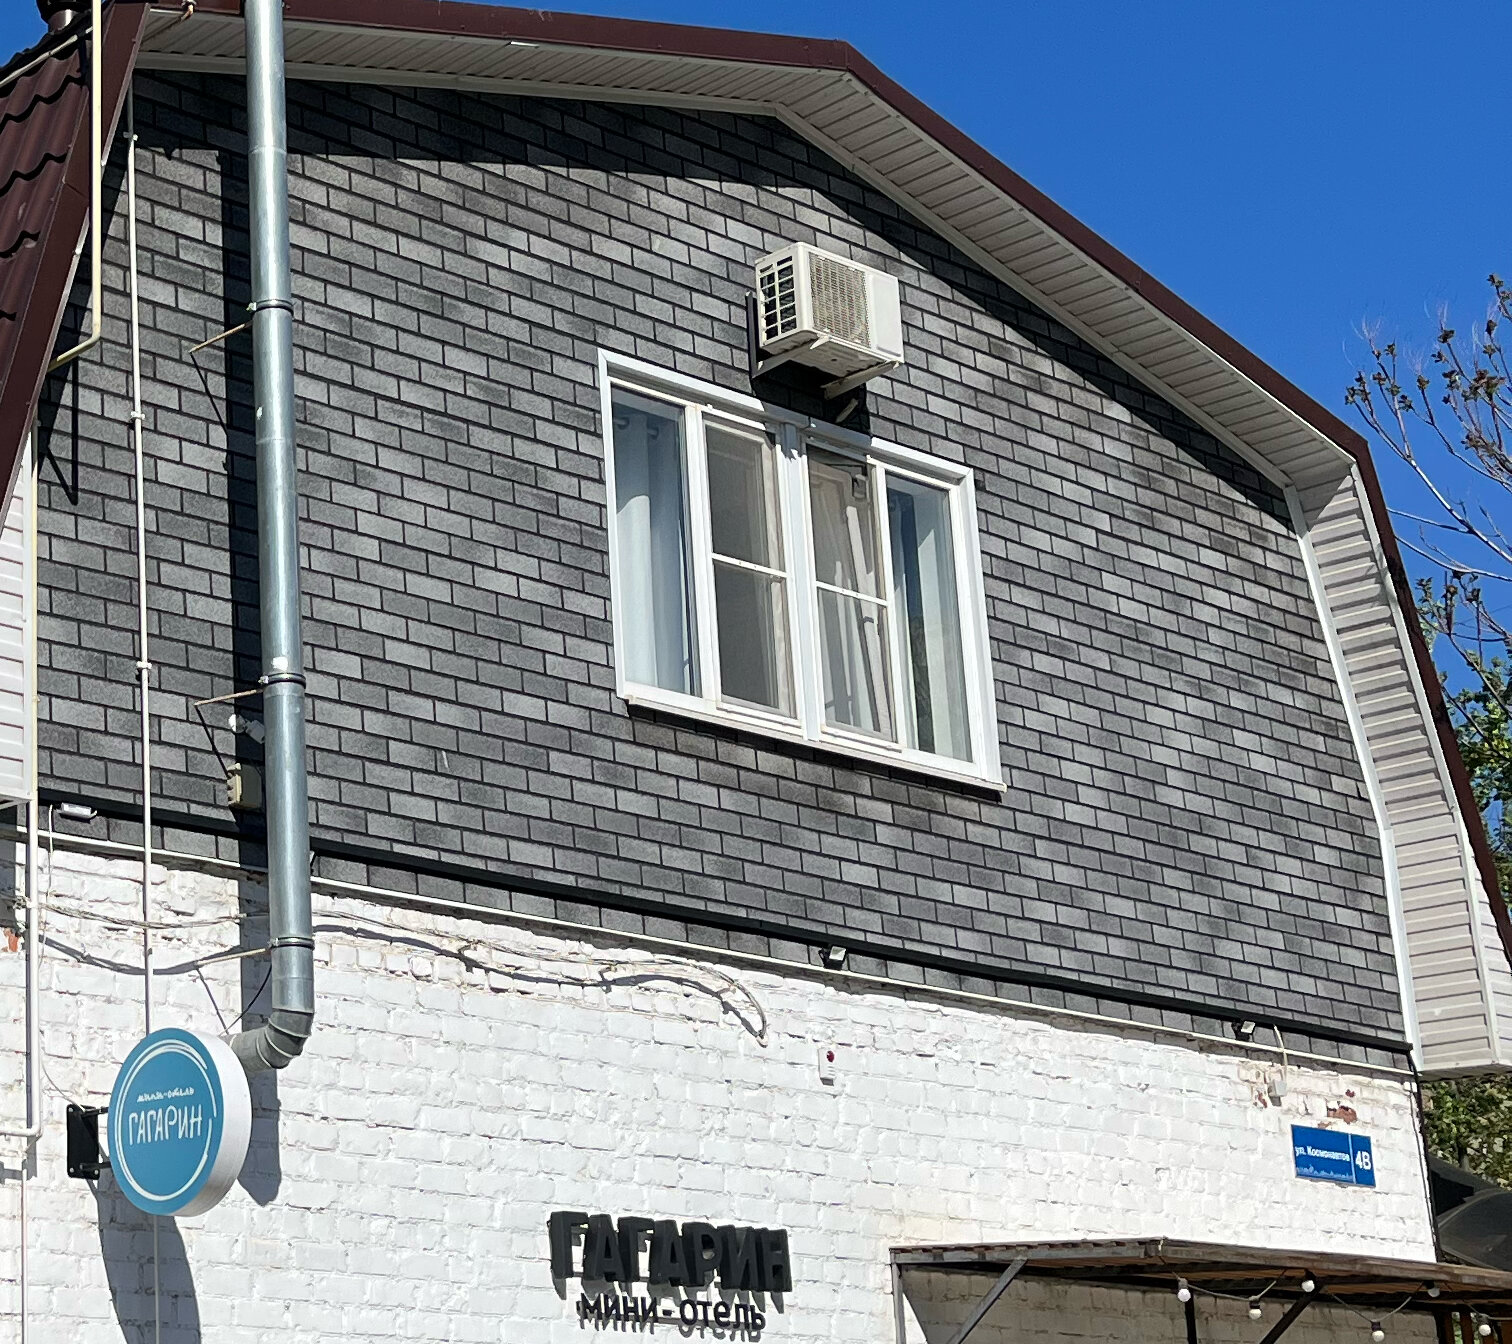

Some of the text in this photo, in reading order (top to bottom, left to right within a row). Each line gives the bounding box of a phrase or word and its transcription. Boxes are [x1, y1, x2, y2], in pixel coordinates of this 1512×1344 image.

[128, 1104, 203, 1145] ГАГАРИН
[1355, 1151, 1372, 1170] 4В
[548, 1211, 792, 1292] ГАГАРИН
